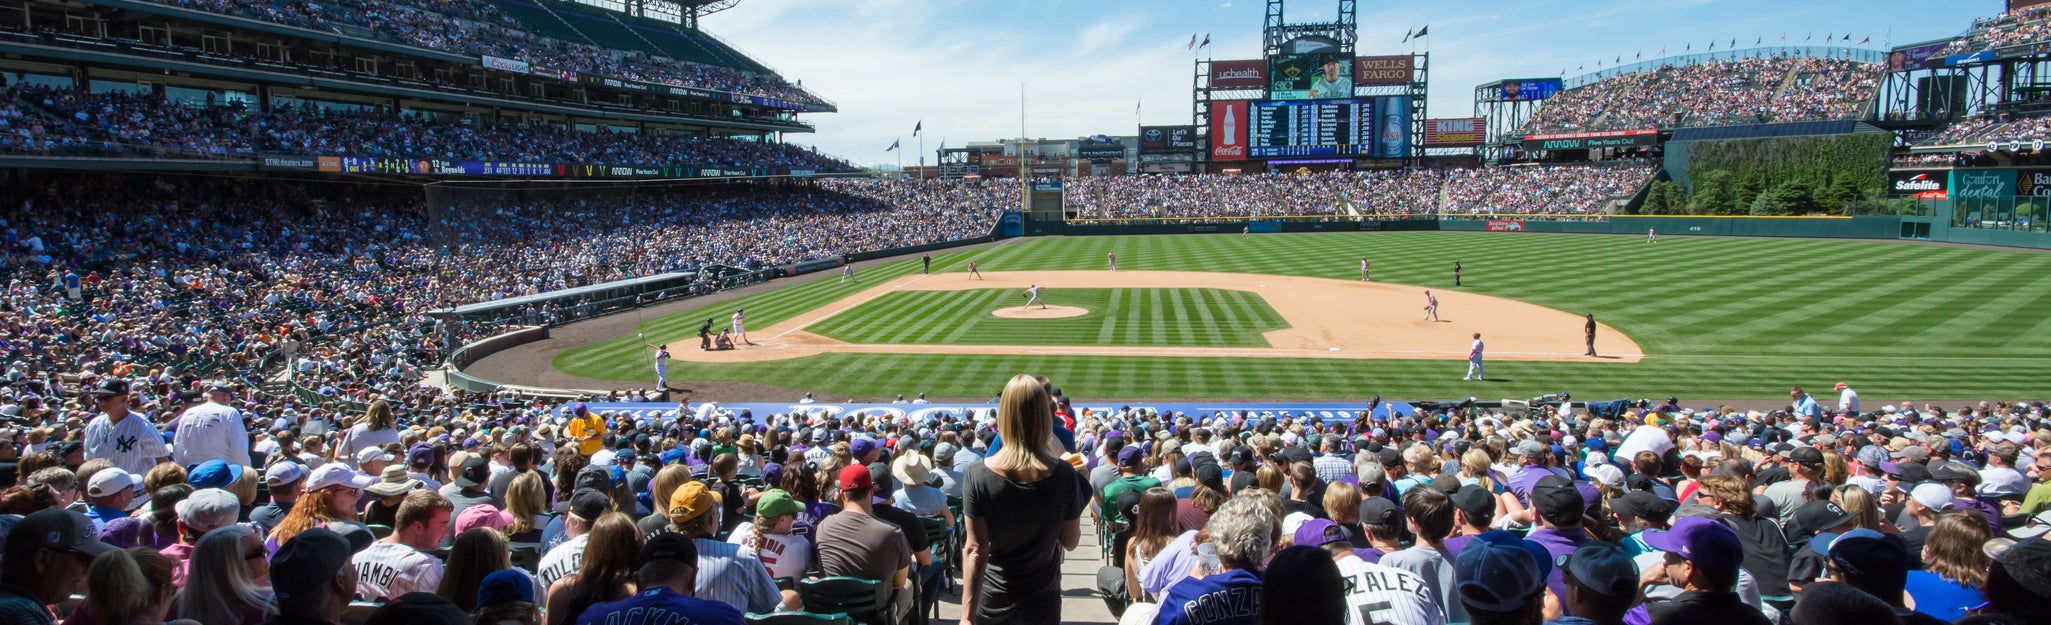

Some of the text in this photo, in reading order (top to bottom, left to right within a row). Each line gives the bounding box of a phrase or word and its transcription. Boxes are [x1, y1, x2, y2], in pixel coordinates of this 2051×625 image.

[511, 63, 529, 73] LIGHT
[1361, 60, 1407, 70] WELLS
[1219, 67, 1260, 79] uchealth
[1362, 70, 1406, 79] FARGO
[1436, 120, 1475, 133] KING
[1436, 132, 1475, 143] Soopers
[1543, 139, 1580, 149] ARROW
[1215, 146, 1243, 156] Coca-Cola
[432, 160, 441, 168] 12
[441, 166, 466, 175] Reynolds
[1963, 171, 2000, 185] Comfort
[1895, 180, 1940, 190] Safelite
[1959, 182, 2005, 198] dental
